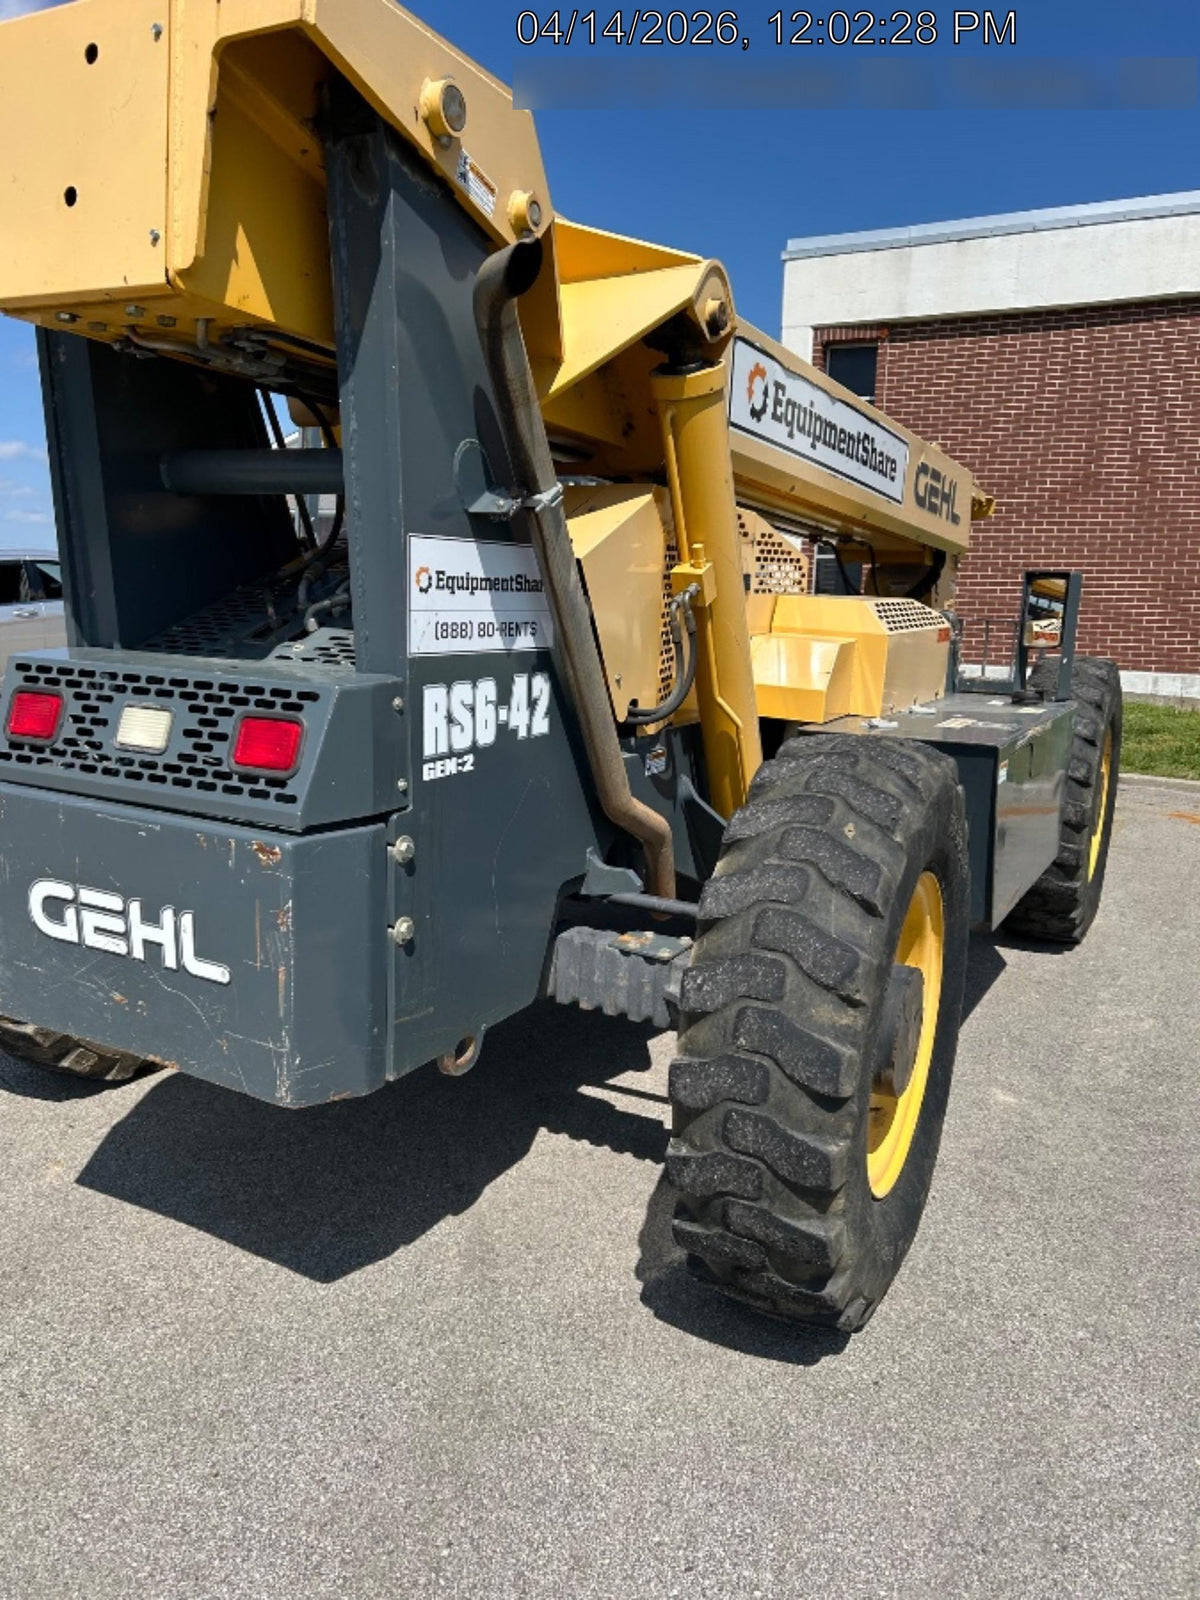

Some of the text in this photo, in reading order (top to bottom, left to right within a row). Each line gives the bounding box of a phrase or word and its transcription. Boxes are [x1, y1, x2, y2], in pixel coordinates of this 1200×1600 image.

[771, 379, 898, 483] EquipmentShare
[913, 461, 961, 526] GEHL
[435, 570, 544, 596] EquipmentShar
[435, 620, 538, 640] (888) 80-RENTS
[422, 671, 551, 760] RS6-42
[28, 878, 231, 985] GEHL
